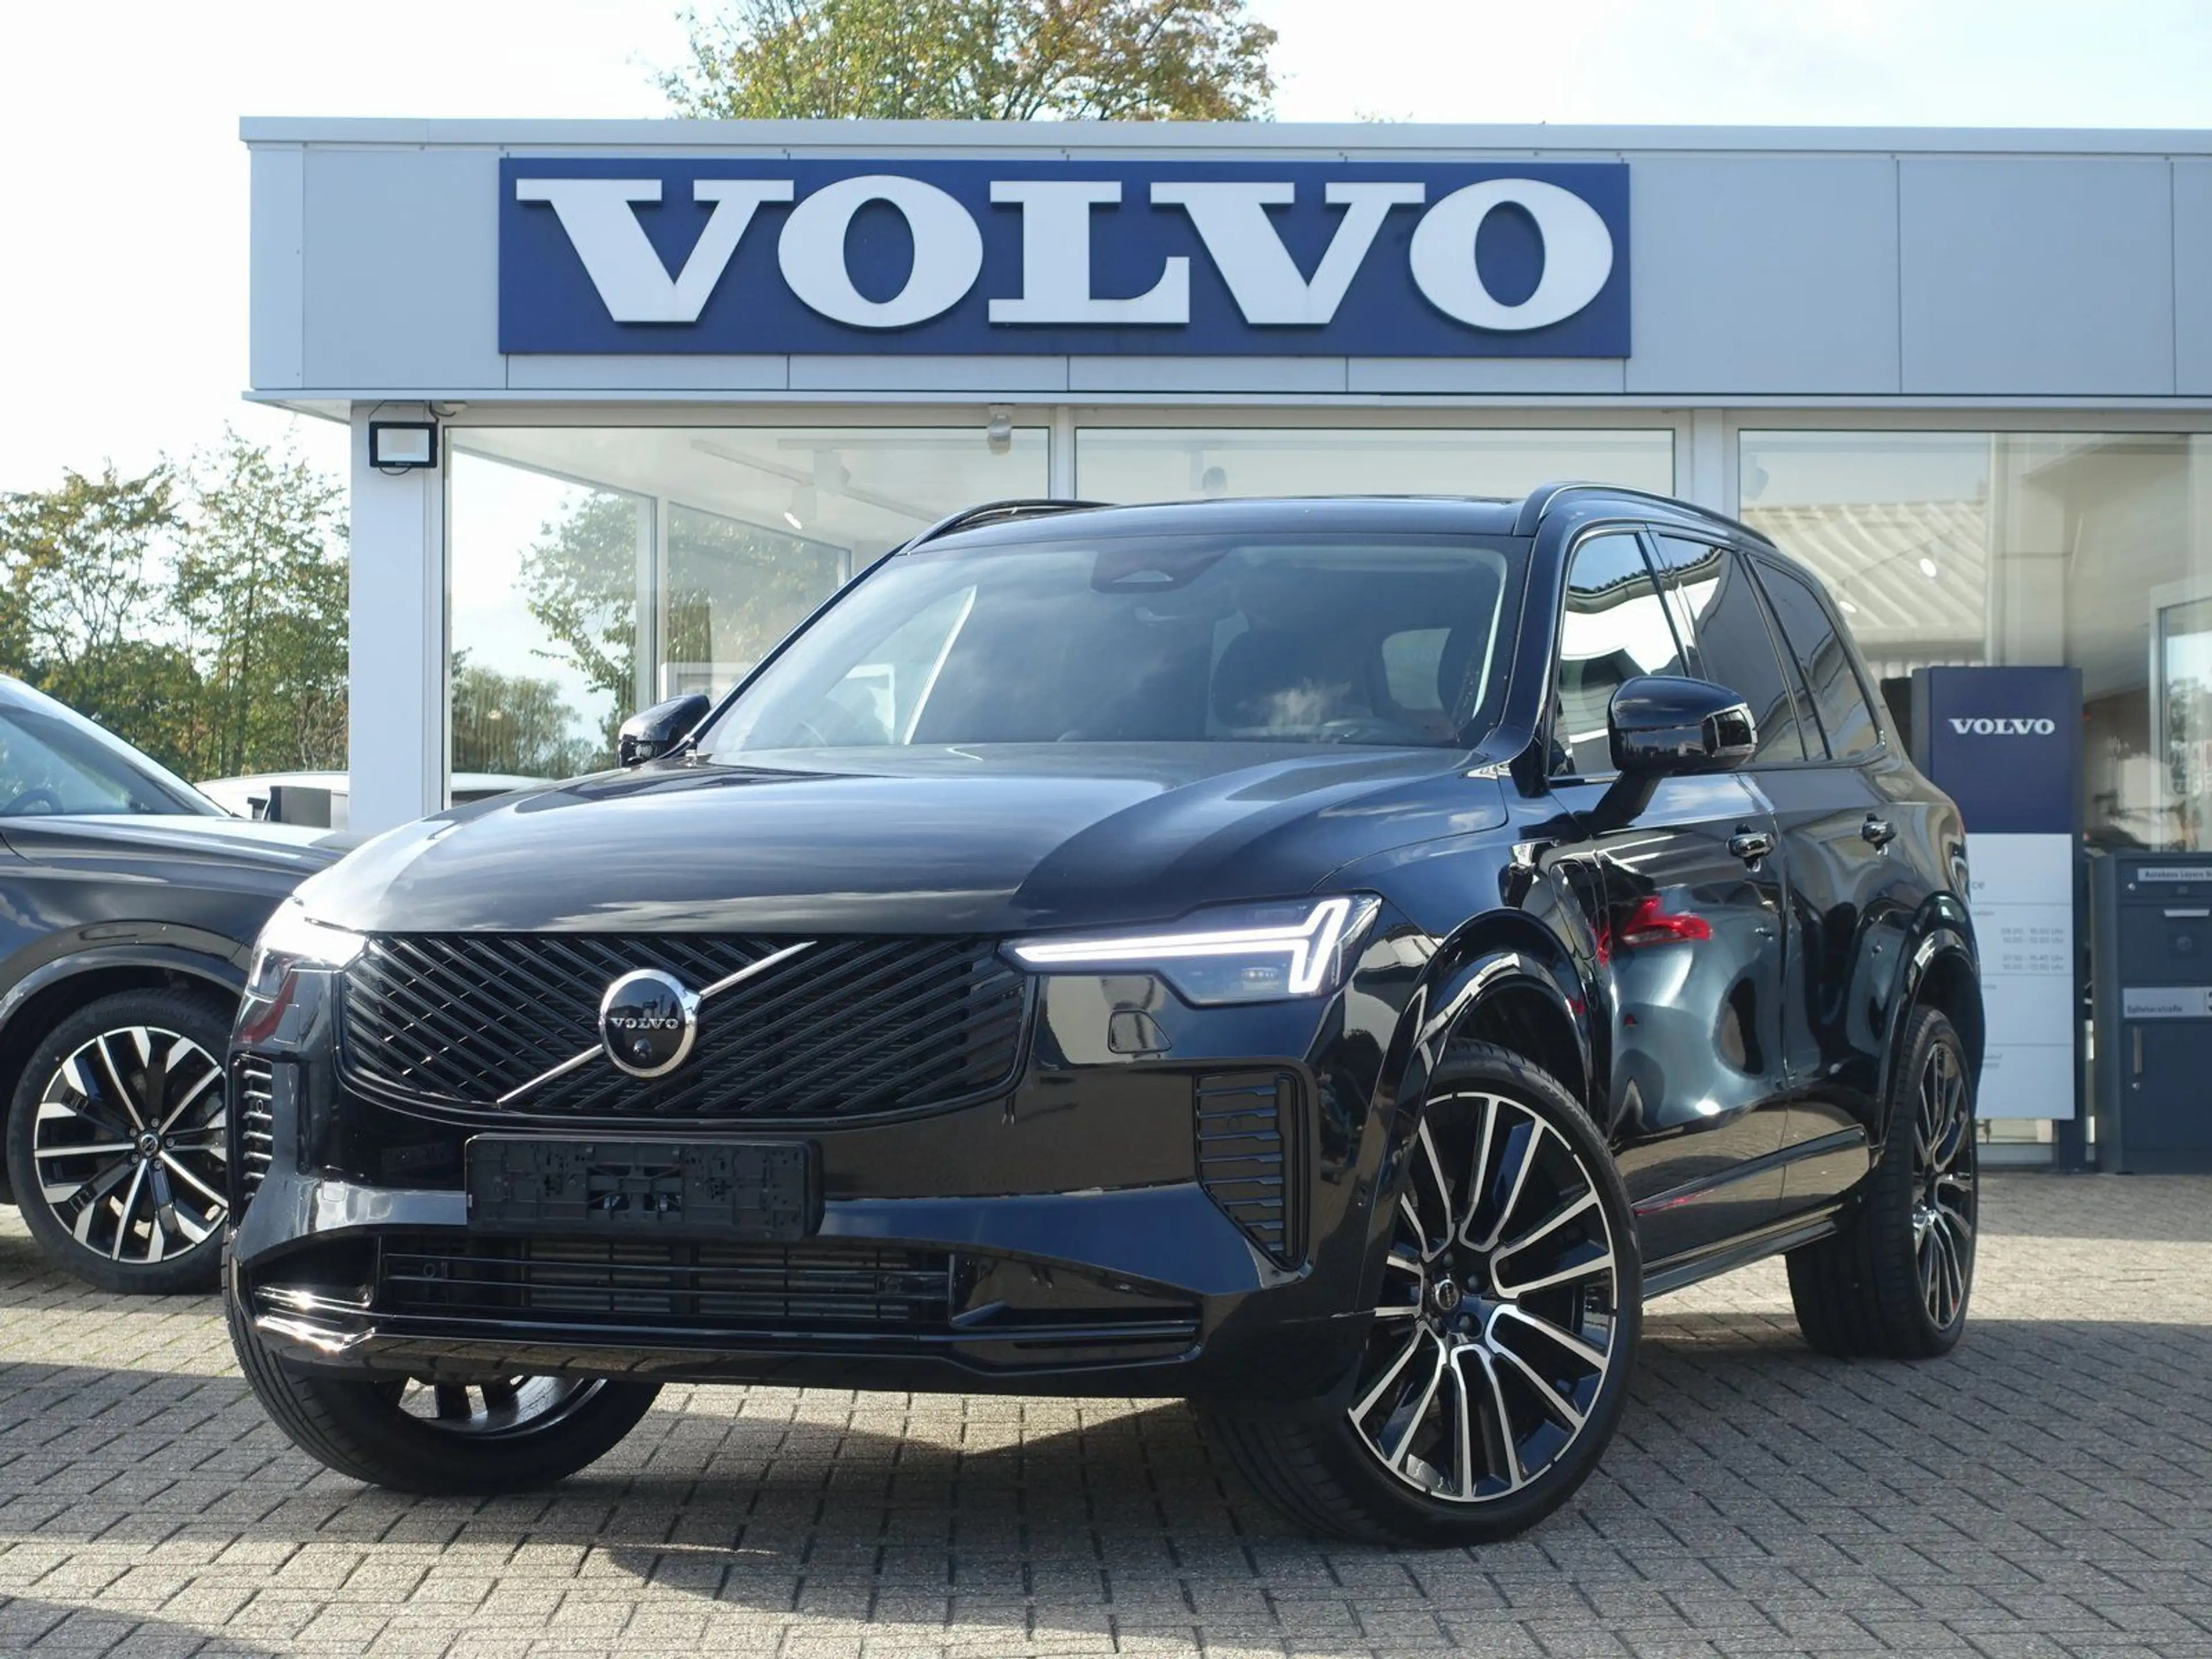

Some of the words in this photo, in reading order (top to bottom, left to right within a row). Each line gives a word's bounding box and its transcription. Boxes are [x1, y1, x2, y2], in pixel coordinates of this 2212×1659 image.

[517, 175, 1614, 331] VOLVO
[1948, 718, 2055, 735] VOLVO
[611, 1017, 679, 1029] VOLVO
